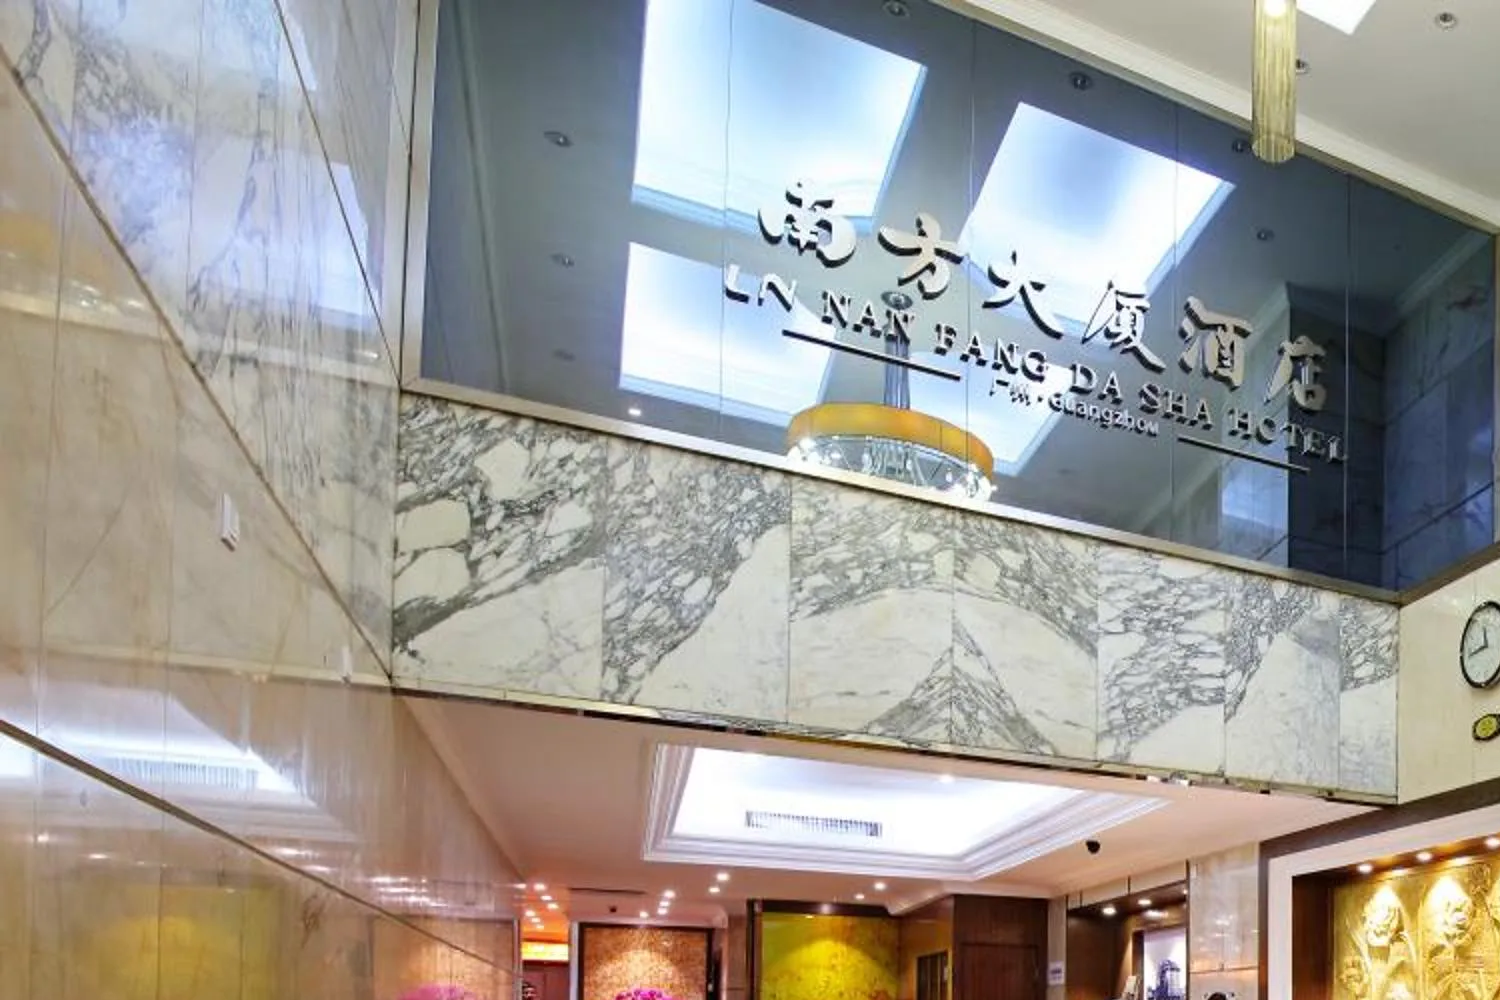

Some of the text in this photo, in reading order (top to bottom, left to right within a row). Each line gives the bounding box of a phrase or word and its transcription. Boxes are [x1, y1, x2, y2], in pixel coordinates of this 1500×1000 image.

[757, 180, 1328, 415] 南方大厦酒店
[820, 289, 924, 345] NAN
[933, 322, 1049, 383] FANG
[1069, 362, 1124, 405] DA
[1138, 382, 1213, 431] SHA
[1228, 407, 1350, 464] HOTEL
